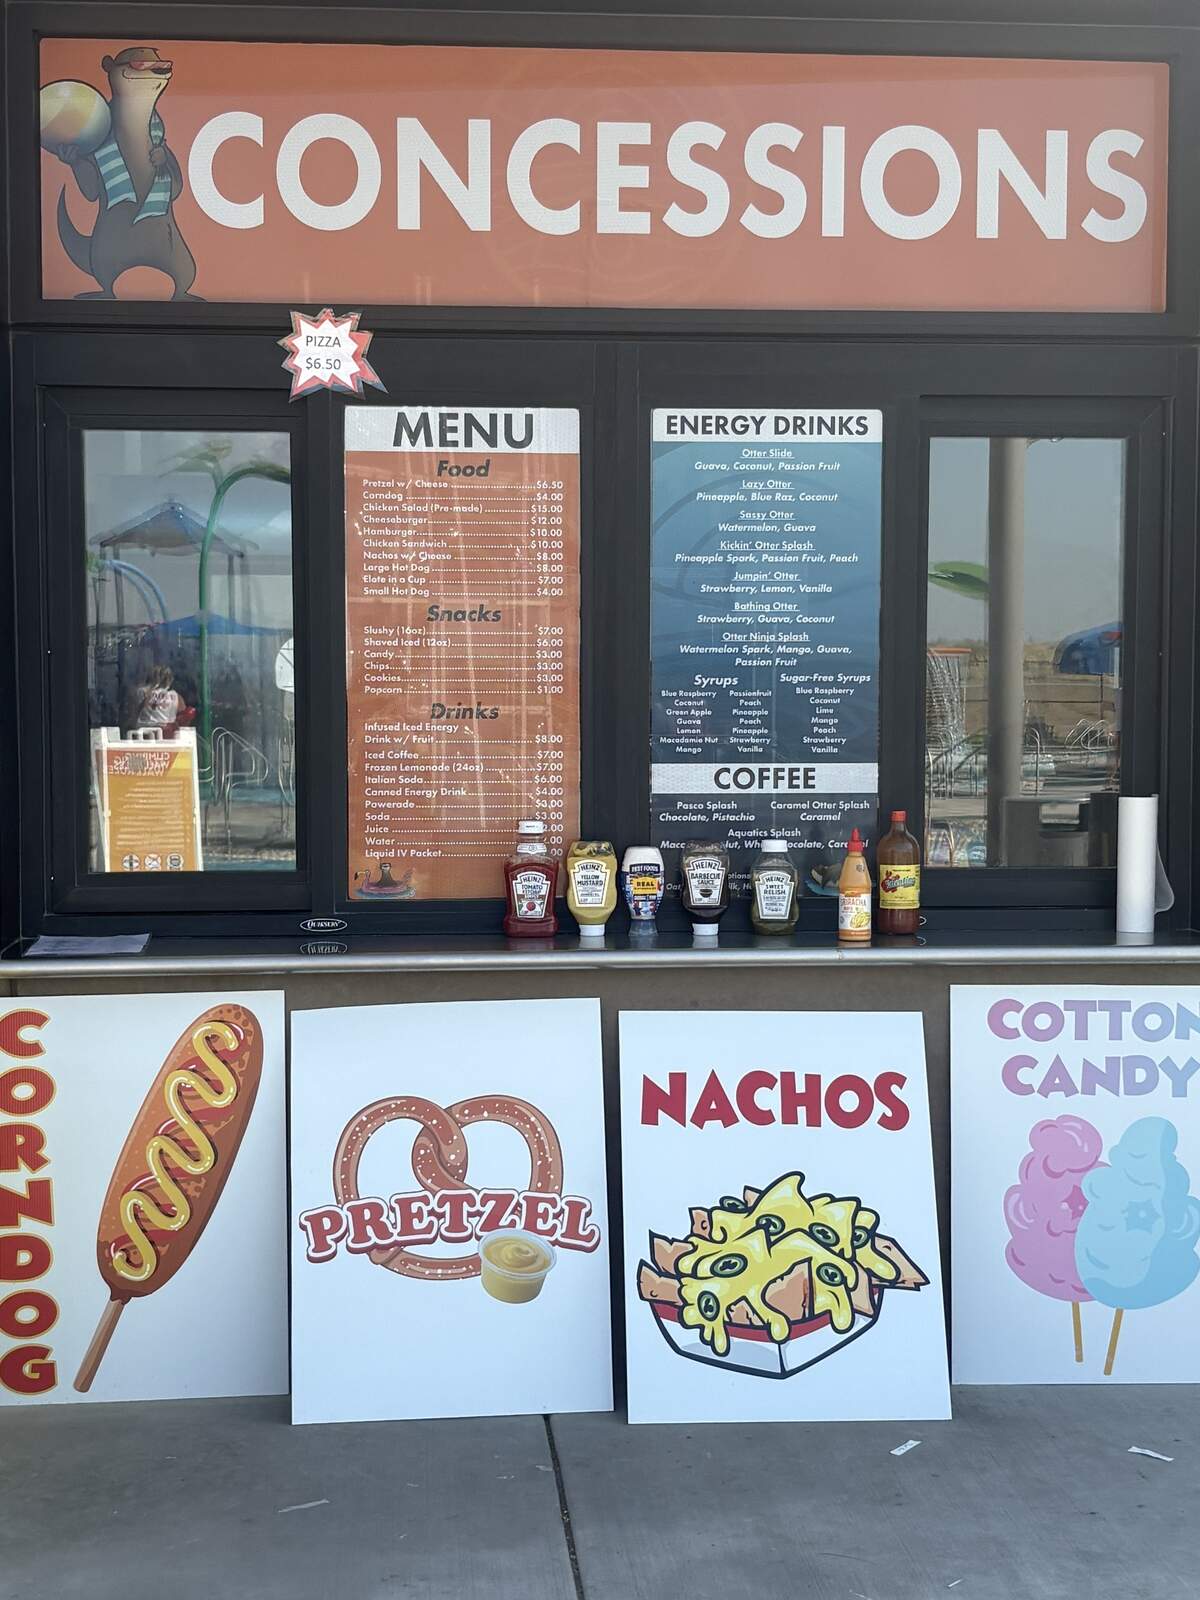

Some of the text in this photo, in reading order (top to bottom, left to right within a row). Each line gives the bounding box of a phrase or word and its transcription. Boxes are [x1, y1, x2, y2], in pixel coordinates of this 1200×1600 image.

[187, 111, 1148, 243] CONCESSIONS
[306, 336, 341, 347] PIZZA
[306, 357, 341, 370] $6.50
[393, 412, 533, 449] MENU
[667, 415, 869, 436] ENERGY DRINKS
[742, 449, 792, 458] Otter Slide
[438, 459, 490, 477] Food
[695, 462, 840, 471] Guava, Coconut, Passion Fruit
[742, 480, 792, 489] Lazy Otter
[363, 491, 563, 502] Corndog $4.00
[696, 493, 747, 502] Pineapple,
[751, 493, 773, 502] Blue
[799, 493, 838, 502] Coconut
[363, 503, 399, 513] Chicken
[402, 503, 428, 513] Salad
[531, 503, 563, 513] $15.00
[532, 515, 562, 525] $12.00
[739, 511, 794, 520] Sassy Otter
[719, 523, 816, 532] Watermelon, Guava
[364, 528, 562, 538] Hamburger $10.00
[364, 540, 563, 549] Chicken Sandwich $10.00
[675, 554, 858, 563] Pineapple Spark, Passion Fruit, Peach
[364, 588, 389, 597] Small
[411, 588, 429, 597] Dog
[537, 588, 563, 597] $4.00
[701, 585, 832, 594] Strawberry, Lemon, Vanilla
[734, 602, 797, 611] Bathing Otter
[427, 605, 502, 622] Snacks
[697, 615, 834, 625] Strawberry, Guava, Coconut
[364, 626, 394, 636] Slushy
[538, 626, 563, 636] $7.00
[722, 632, 809, 642] Otter Ninja Splash
[364, 638, 399, 647] Shaved
[536, 638, 563, 647] $6.00
[364, 649, 562, 660] Candy $3.00
[680, 645, 852, 656] Watermelon Spark, Mango, Guava,
[364, 661, 563, 672] Chips $3.00
[735, 658, 797, 666] Passion Fruit
[365, 673, 563, 683] Cookies $3.00
[694, 675, 738, 686] Syrups
[837, 674, 871, 684] Syrups
[365, 685, 563, 696] Popcorn $1.00
[431, 703, 500, 720] Drinks
[365, 722, 458, 734] Infused Iced Energy
[365, 735, 391, 744] Drink
[412, 735, 434, 744] Fruit
[535, 735, 562, 744] $8.00
[365, 751, 563, 760] Iced Coffee $7.00
[365, 763, 563, 773] Frozen Lemonade (24oz) $7.00
[365, 775, 562, 785] Italian Soda $6.00
[714, 767, 816, 789] COFFEE
[365, 787, 563, 798] Canned Energy Drink $4.00
[365, 800, 563, 809] Powerade $3.00
[677, 802, 737, 812] Pasco Splash
[770, 801, 870, 811] Caramel Otter Splash
[365, 812, 562, 821] Soda $3.00
[659, 813, 755, 822] Chocolate, Pistachio
[800, 812, 841, 821] Caramel
[365, 825, 388, 834] Juice
[728, 829, 801, 839] Aquatics Splash
[365, 837, 395, 846] Water
[366, 849, 442, 860] Liquid IV Packet
[987, 998, 1200, 1042] COTTON
[1001, 1054, 1200, 1098] CANDY
[641, 1069, 910, 1131] NACHOS
[0, 1009, 59, 1396] CORNDOG
[299, 1188, 601, 1264] PRETZEL
